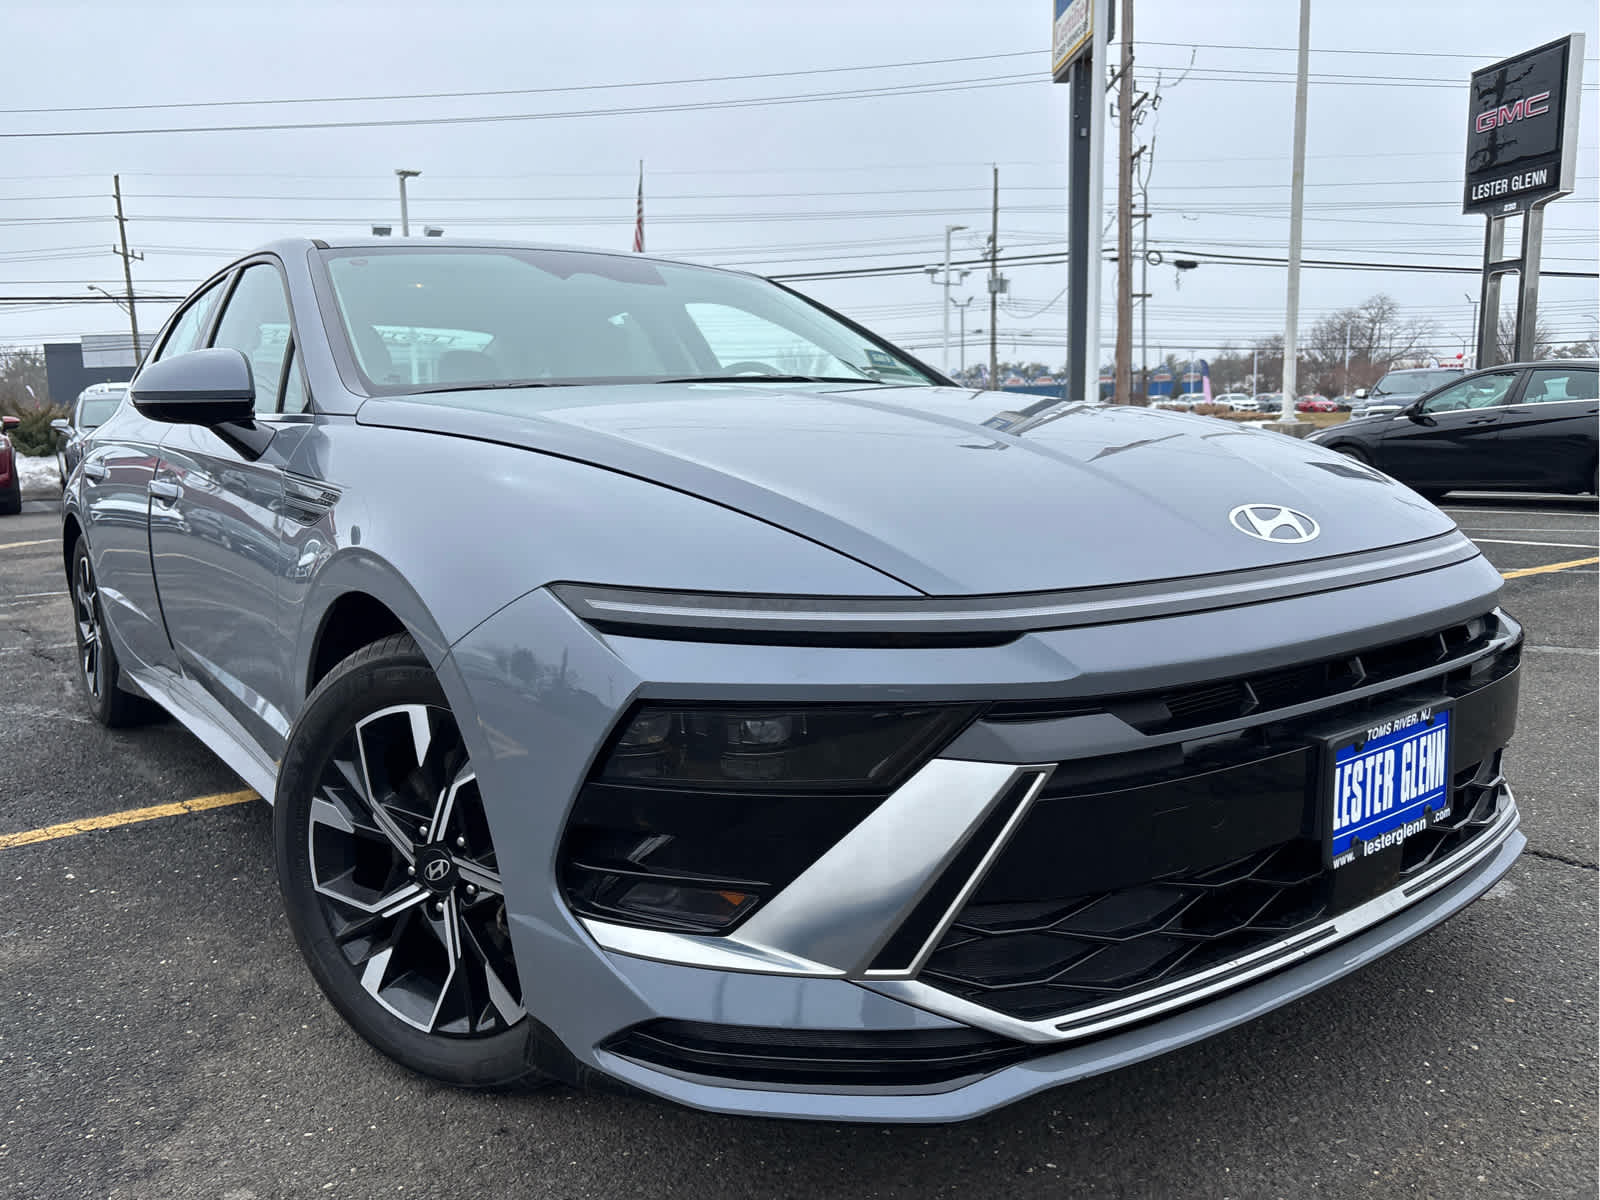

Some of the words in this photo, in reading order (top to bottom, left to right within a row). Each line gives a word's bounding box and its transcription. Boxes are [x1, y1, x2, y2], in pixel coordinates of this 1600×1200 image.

[1475, 91, 1550, 133] GMC
[1472, 179, 1508, 200] LESTER
[1511, 168, 1548, 191] GLENN
[1367, 723, 1392, 741] TOMS
[1420, 708, 1431, 721] NJ
[1333, 749, 1395, 831] LESTER
[1400, 728, 1446, 803] GLENN
